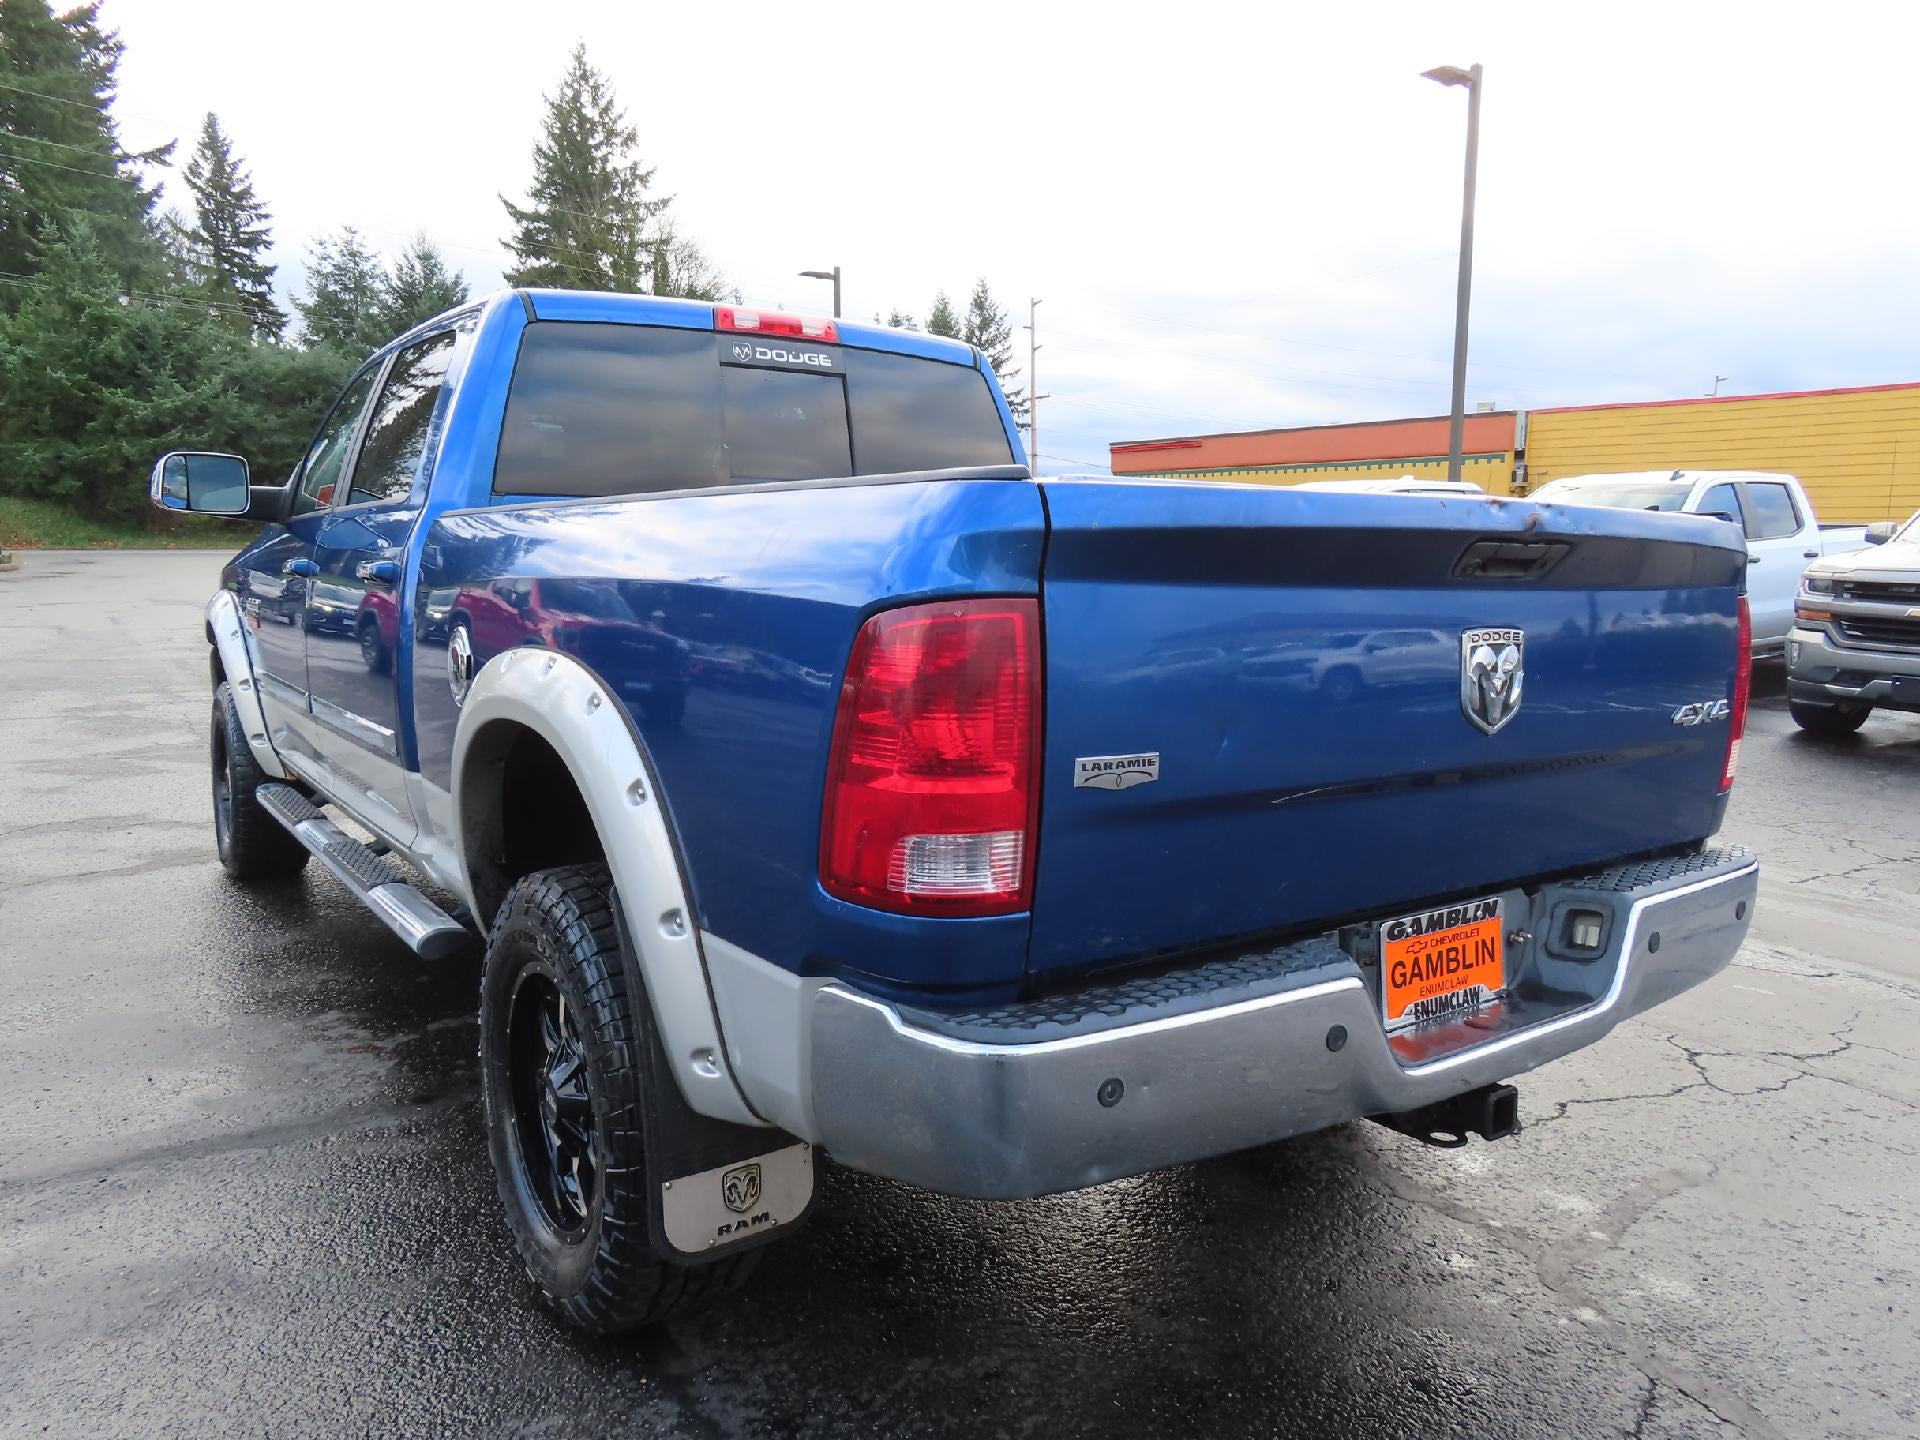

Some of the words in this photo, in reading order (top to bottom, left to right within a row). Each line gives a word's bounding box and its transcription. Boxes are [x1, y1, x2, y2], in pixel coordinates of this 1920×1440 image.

[1471, 631, 1521, 644] DODGE
[1081, 758, 1156, 772] LARAMIE
[1387, 899, 1499, 942] GAMBLIN
[1430, 927, 1481, 948] CHEVROLET
[1391, 936, 1495, 989] GAMBLIN
[1420, 974, 1469, 997] ENUMCLAW
[1414, 984, 1481, 1017] ENUMCLAW
[717, 1211, 770, 1237] RAM
